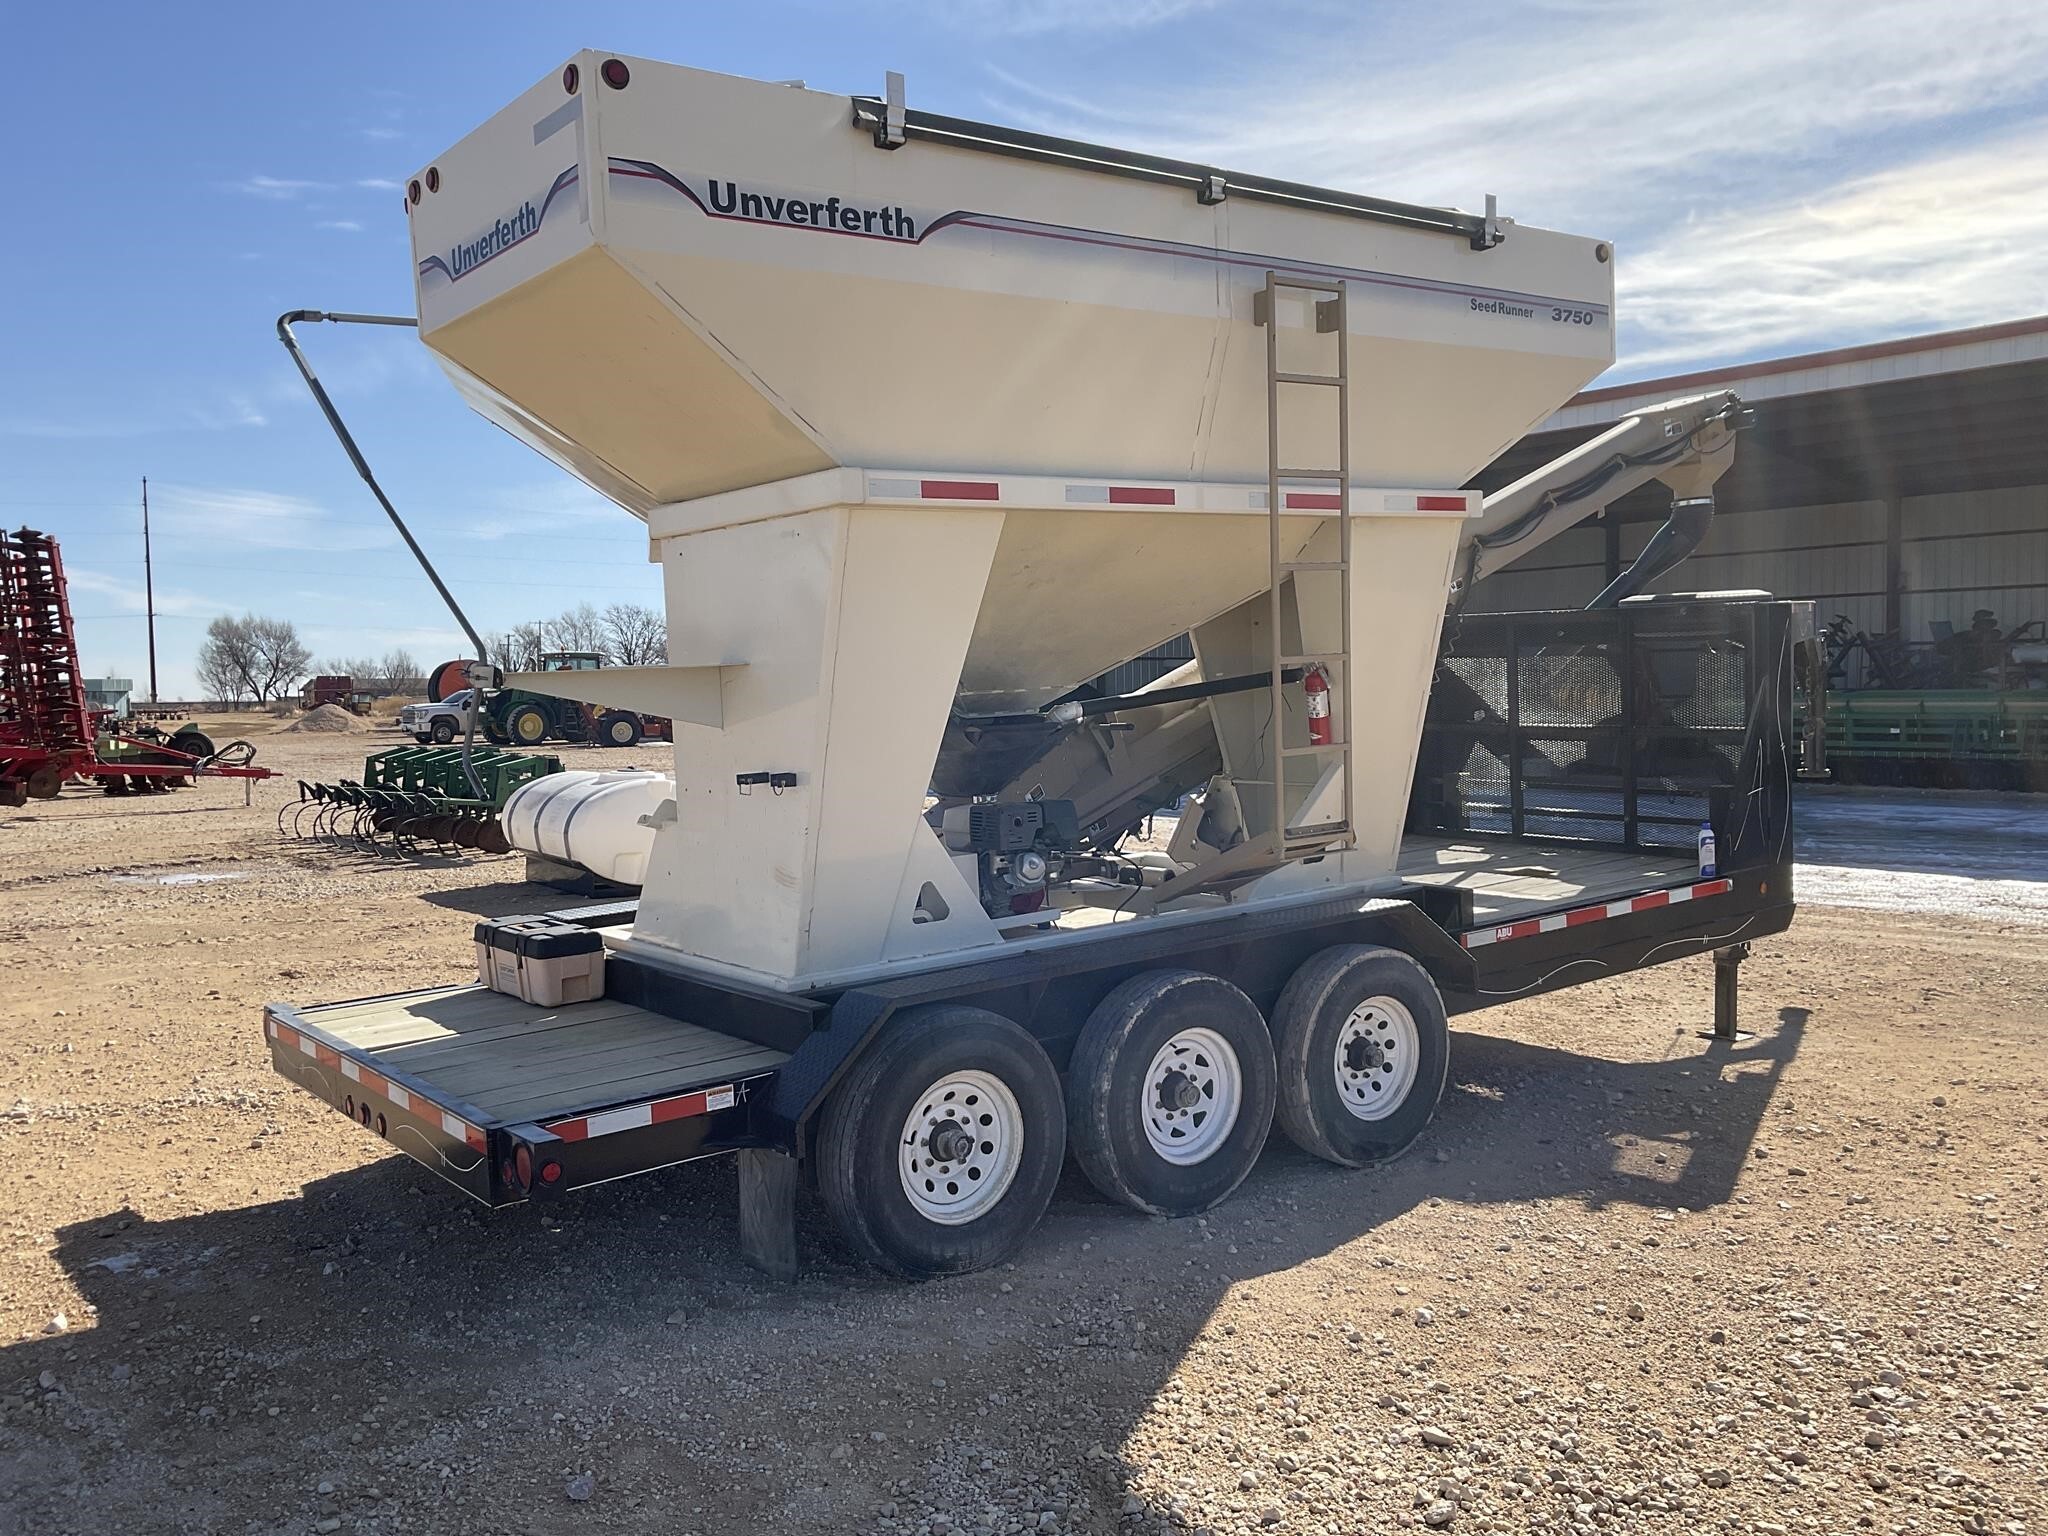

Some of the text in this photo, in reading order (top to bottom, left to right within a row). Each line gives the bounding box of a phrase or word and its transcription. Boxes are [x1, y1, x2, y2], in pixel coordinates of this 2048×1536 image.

[708, 179, 915, 239] Unverferth
[451, 201, 537, 275] Unverferth
[1470, 298, 1534, 319] Seed Runner
[1551, 307, 1594, 326] 3750
[1497, 926, 1513, 938] ABU
